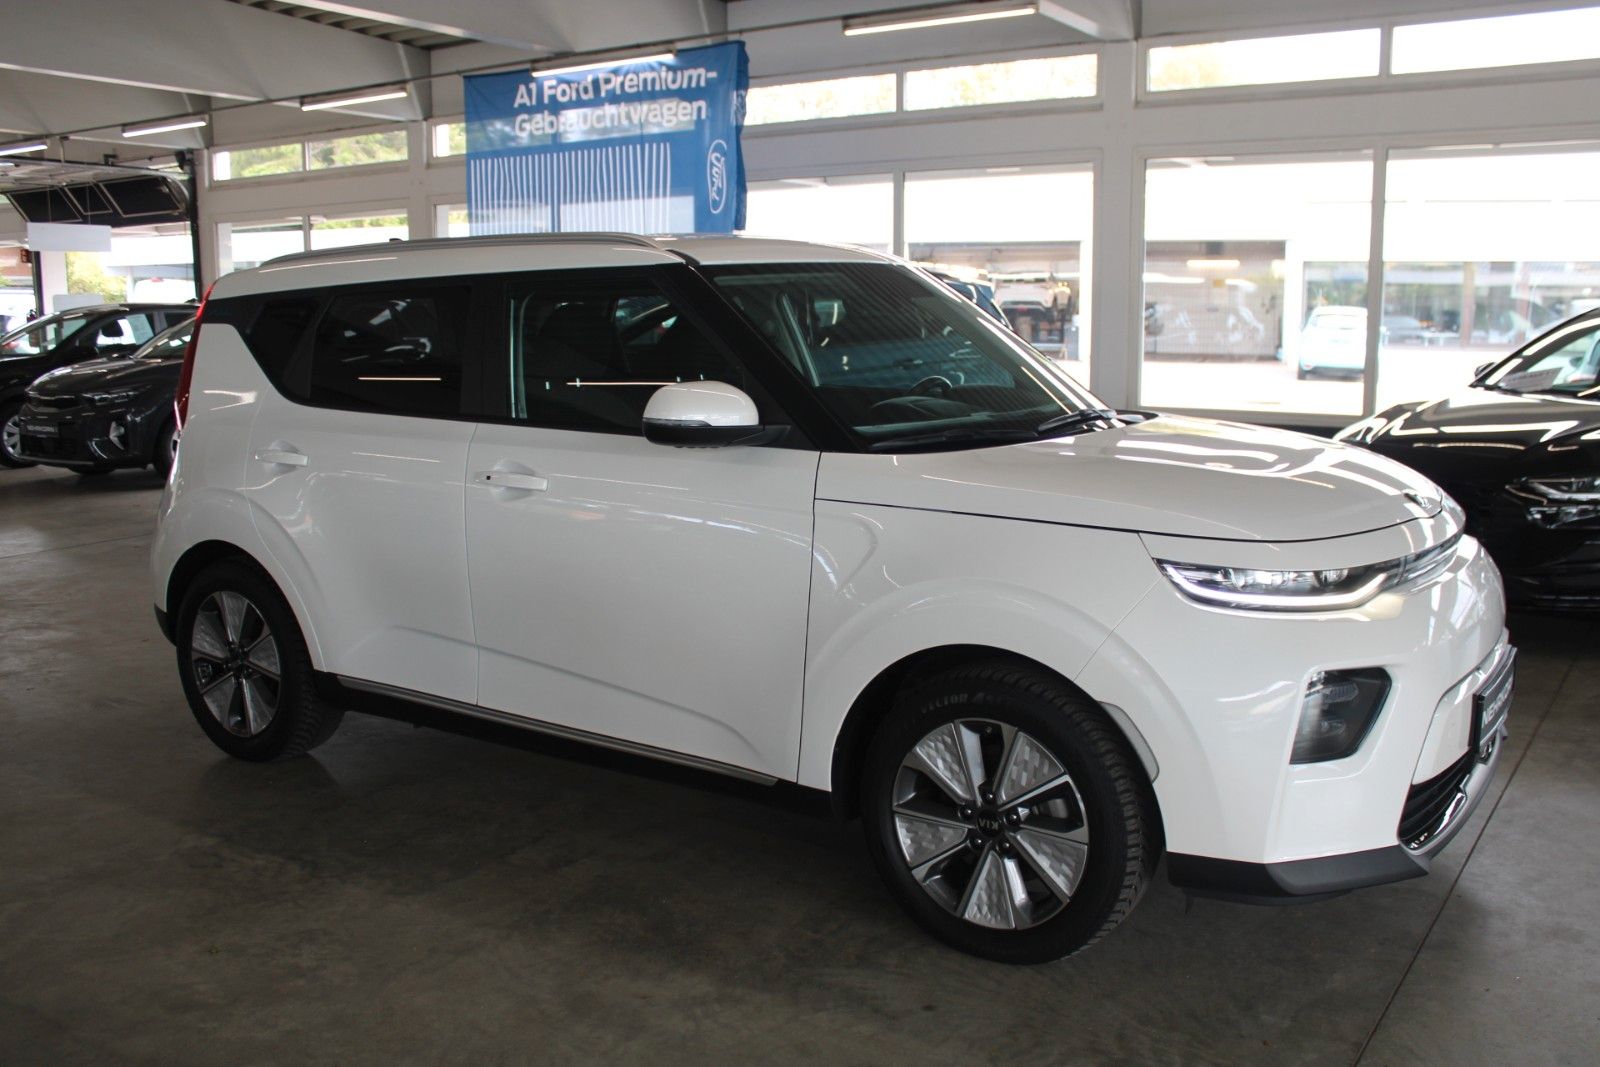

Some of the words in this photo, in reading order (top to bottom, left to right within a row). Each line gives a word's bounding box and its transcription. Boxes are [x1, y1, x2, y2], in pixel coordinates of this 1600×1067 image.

[543, 76, 594, 105] Ford
[600, 66, 718, 98] Premium-
[514, 99, 707, 137] Gebrauchtwagen
[710, 150, 726, 202] Ford
[979, 817, 999, 831] KIA
